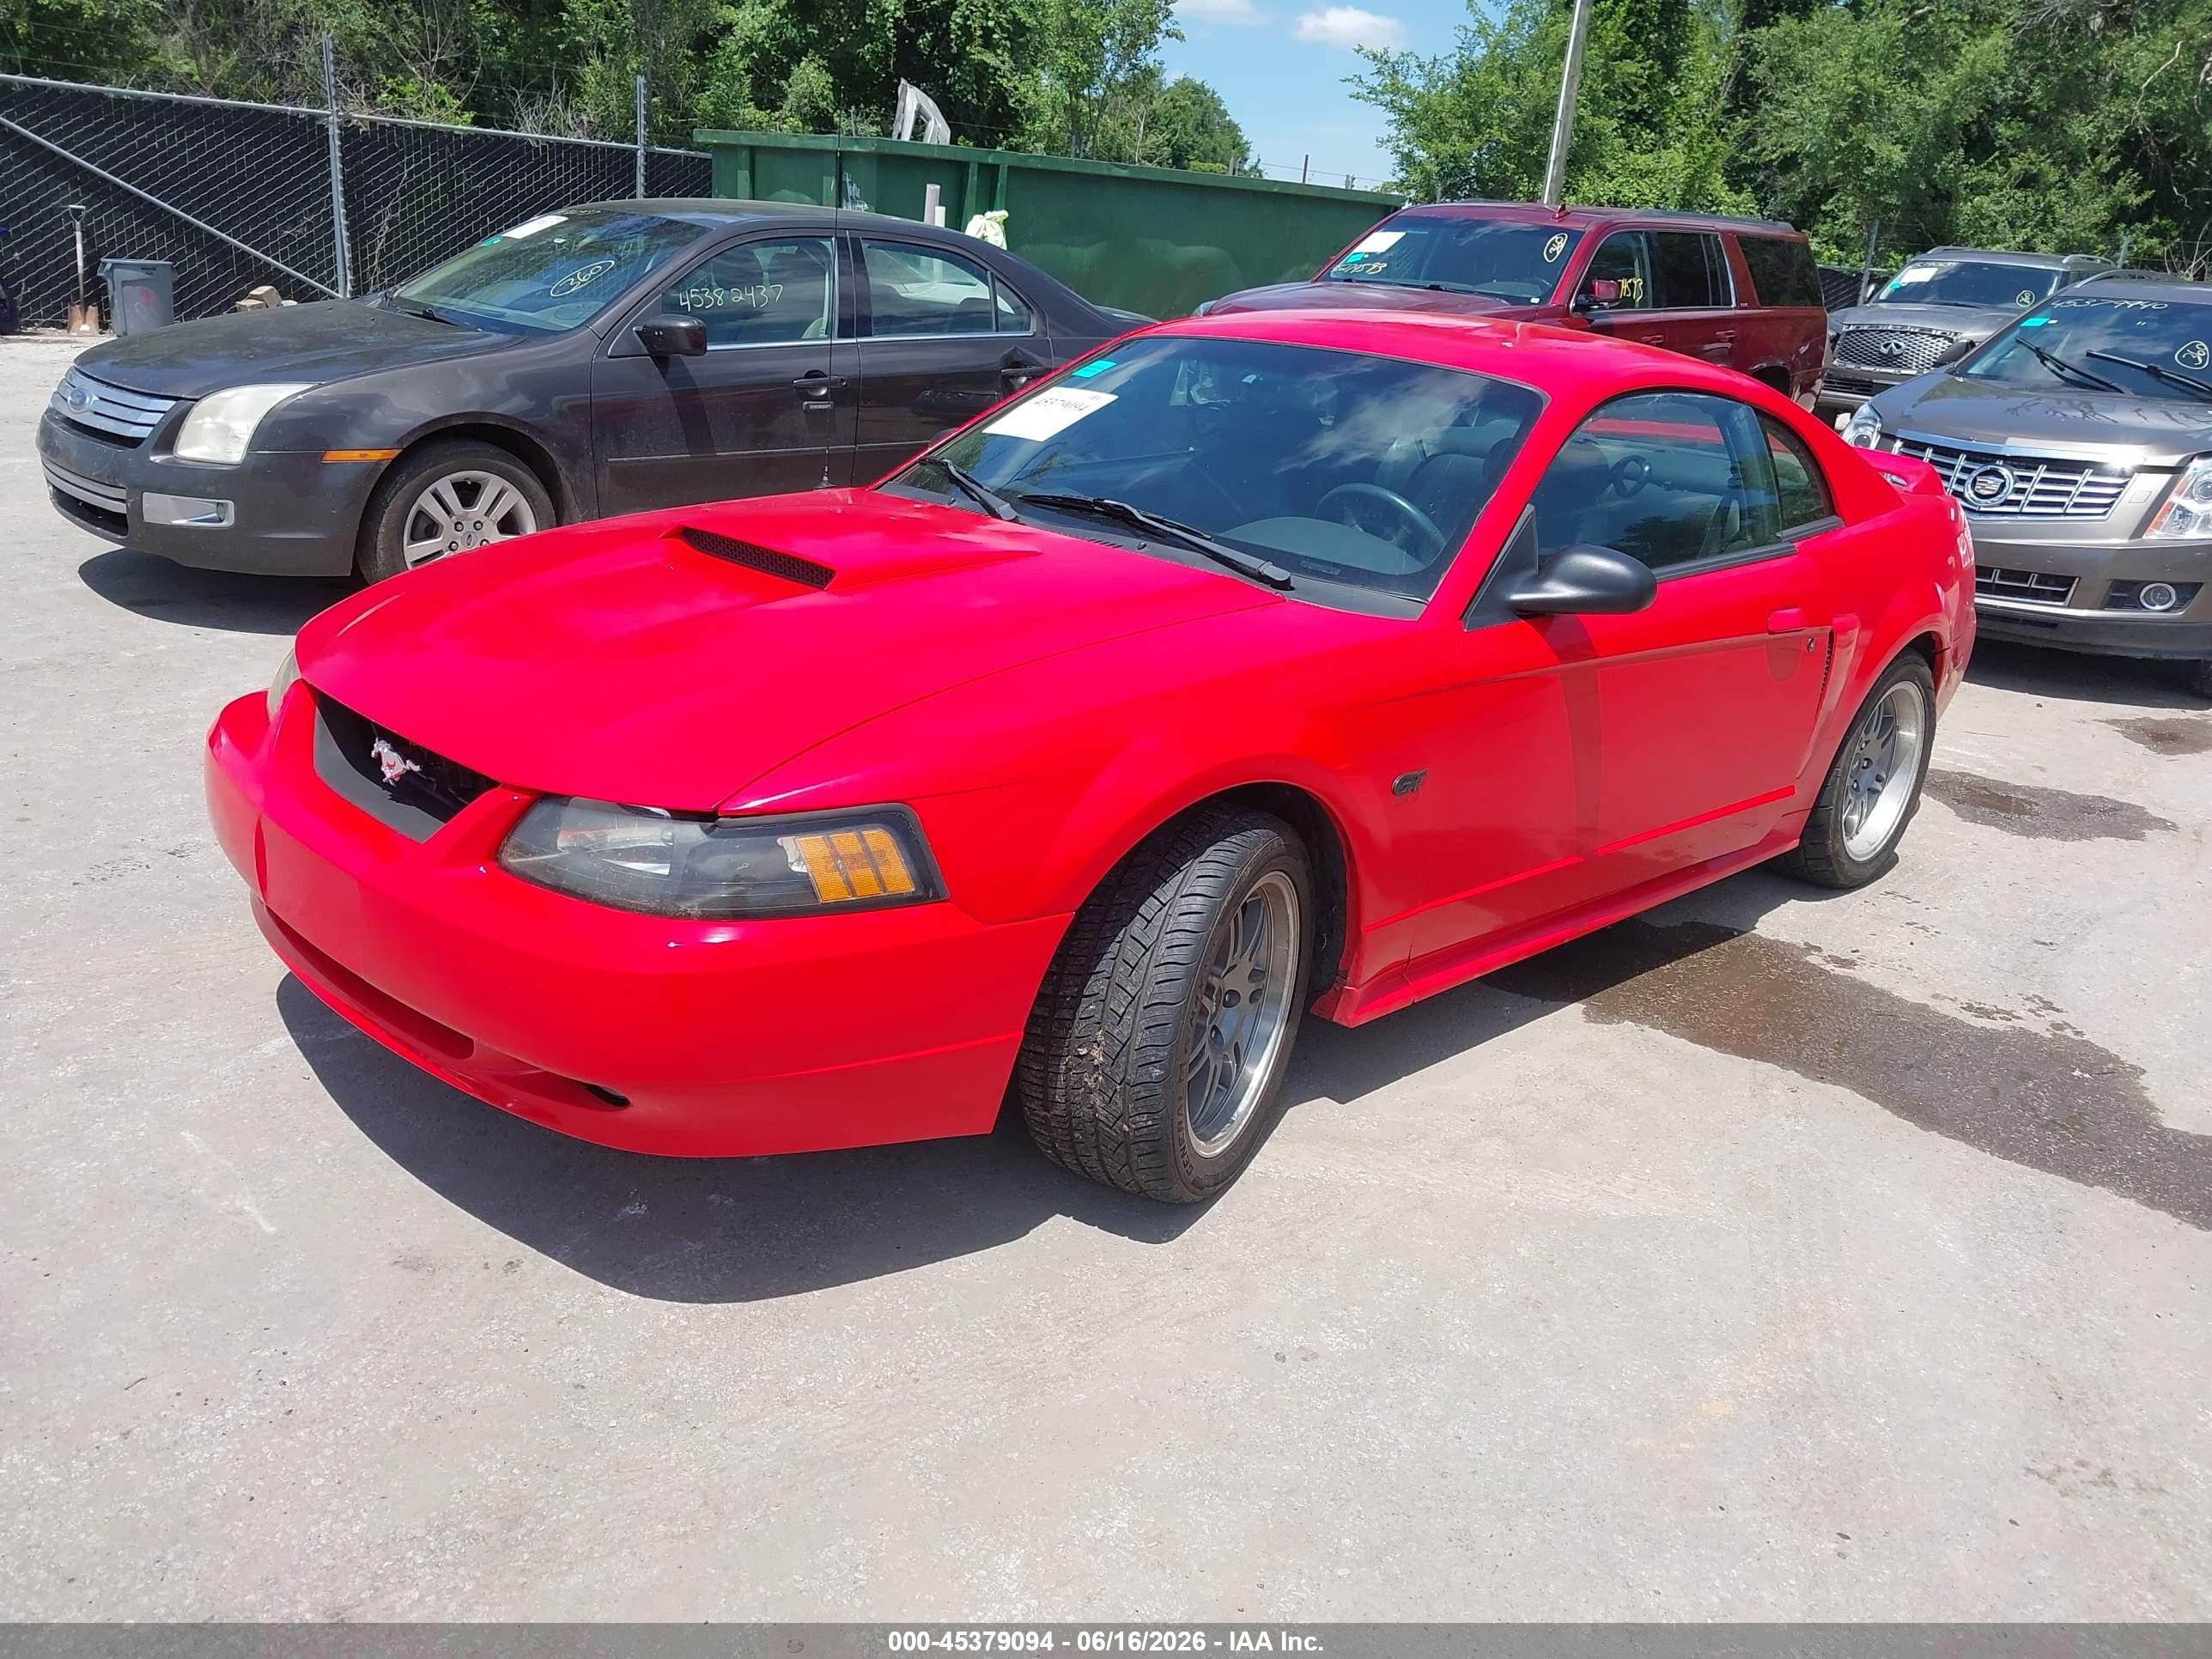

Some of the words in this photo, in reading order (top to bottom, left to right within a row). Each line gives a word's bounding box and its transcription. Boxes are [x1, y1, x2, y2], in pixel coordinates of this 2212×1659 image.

[558, 265, 602, 292] 360
[679, 283, 784, 312] 45382437
[2182, 343, 2208, 366] 360
